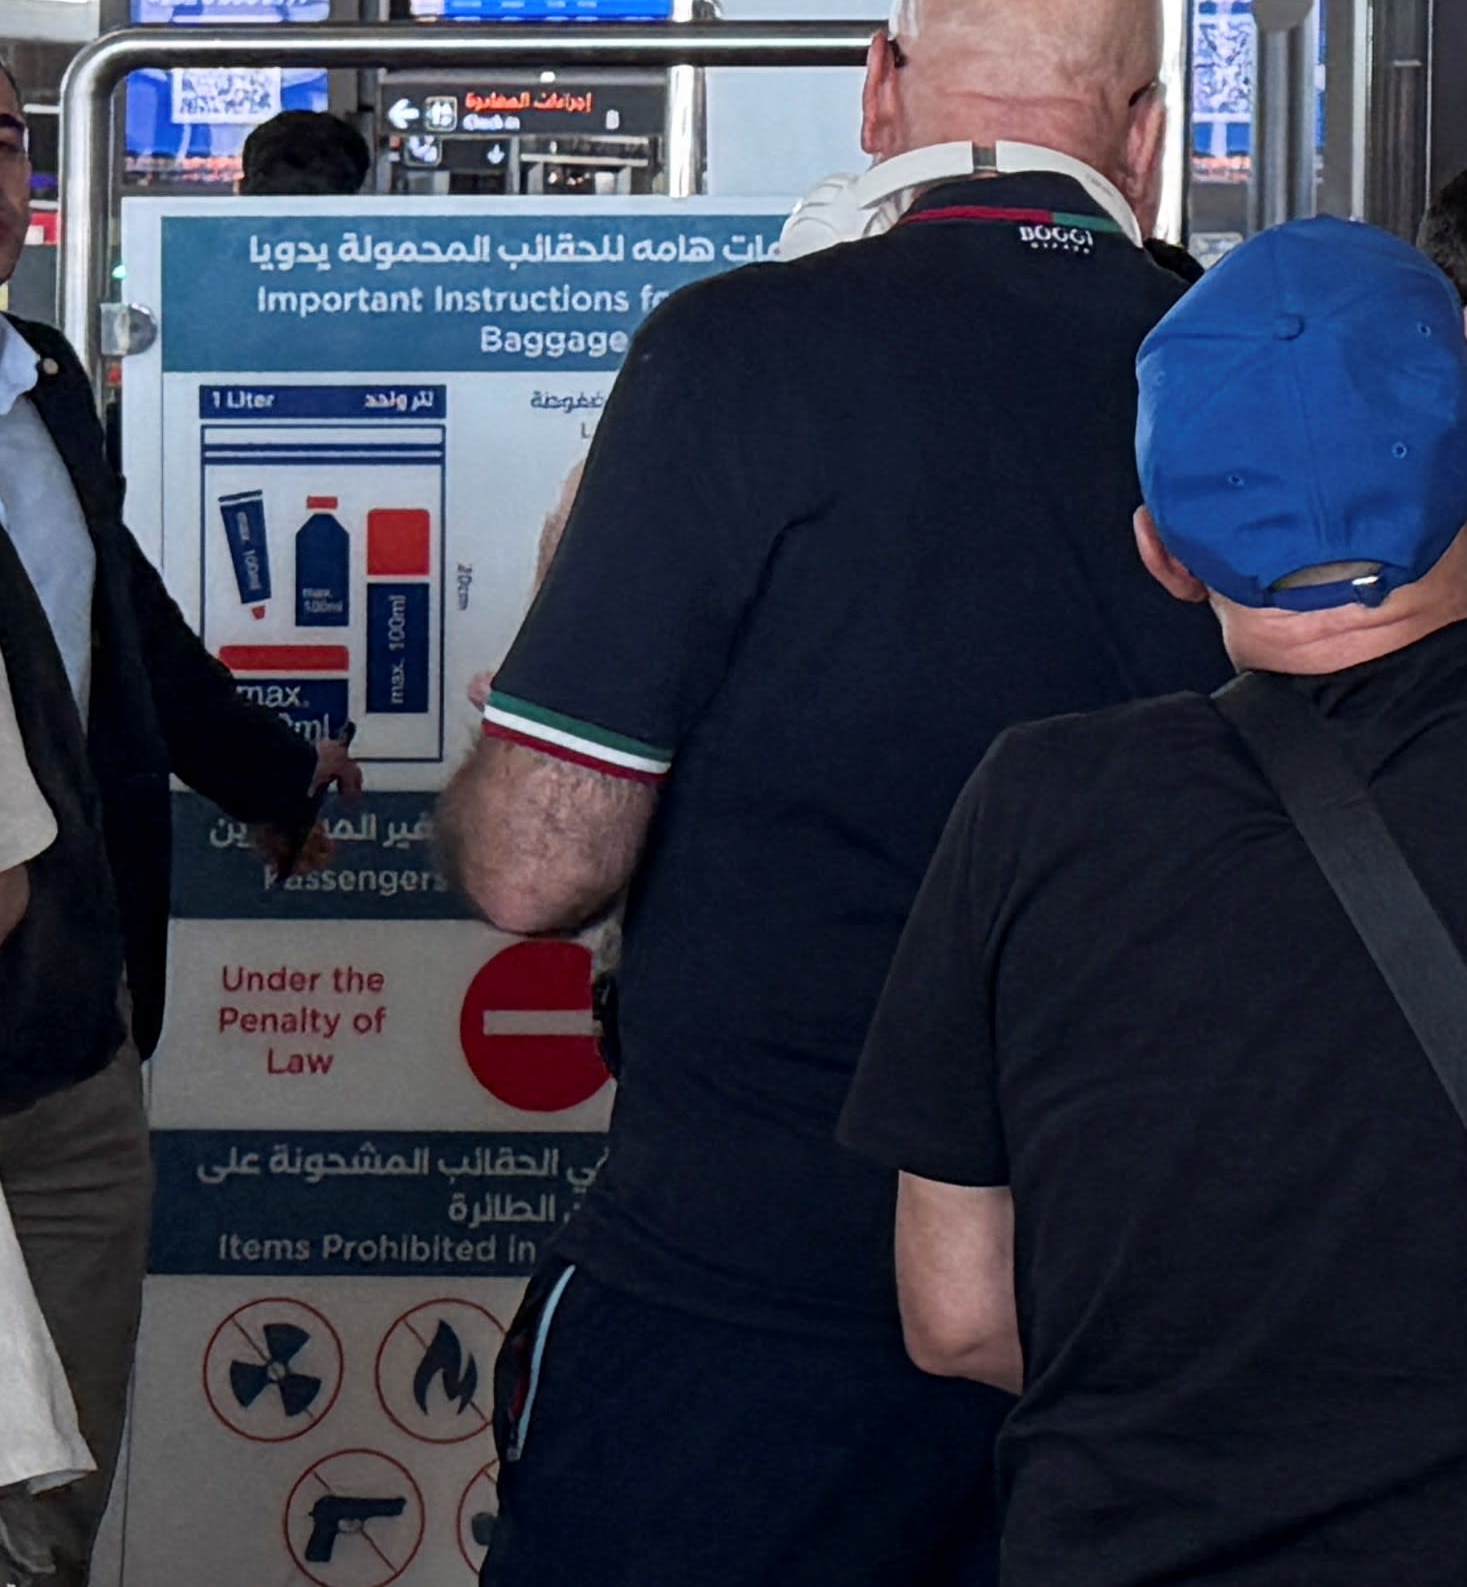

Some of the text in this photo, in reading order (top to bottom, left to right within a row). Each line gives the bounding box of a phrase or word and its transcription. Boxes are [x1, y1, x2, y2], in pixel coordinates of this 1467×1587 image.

[250, 235, 331, 271] يدويا
[338, 232, 491, 271] المحمولة
[497, 233, 625, 270] للحقائب
[632, 233, 715, 263] هامه
[257, 284, 629, 319] Important Instructions
[481, 326, 629, 358] Baggage
[211, 391, 275, 408] 1 Liter
[389, 594, 406, 651] 100ml
[222, 966, 384, 993] Under the
[219, 1006, 386, 1039] Penalty of
[267, 1048, 334, 1074] Law
[197, 1146, 262, 1184] على
[268, 1140, 430, 1183] المشحونة
[437, 1146, 559, 1185] الحقائب
[448, 1192, 556, 1229] الطائرة
[219, 1233, 496, 1261] Items Prohibited
